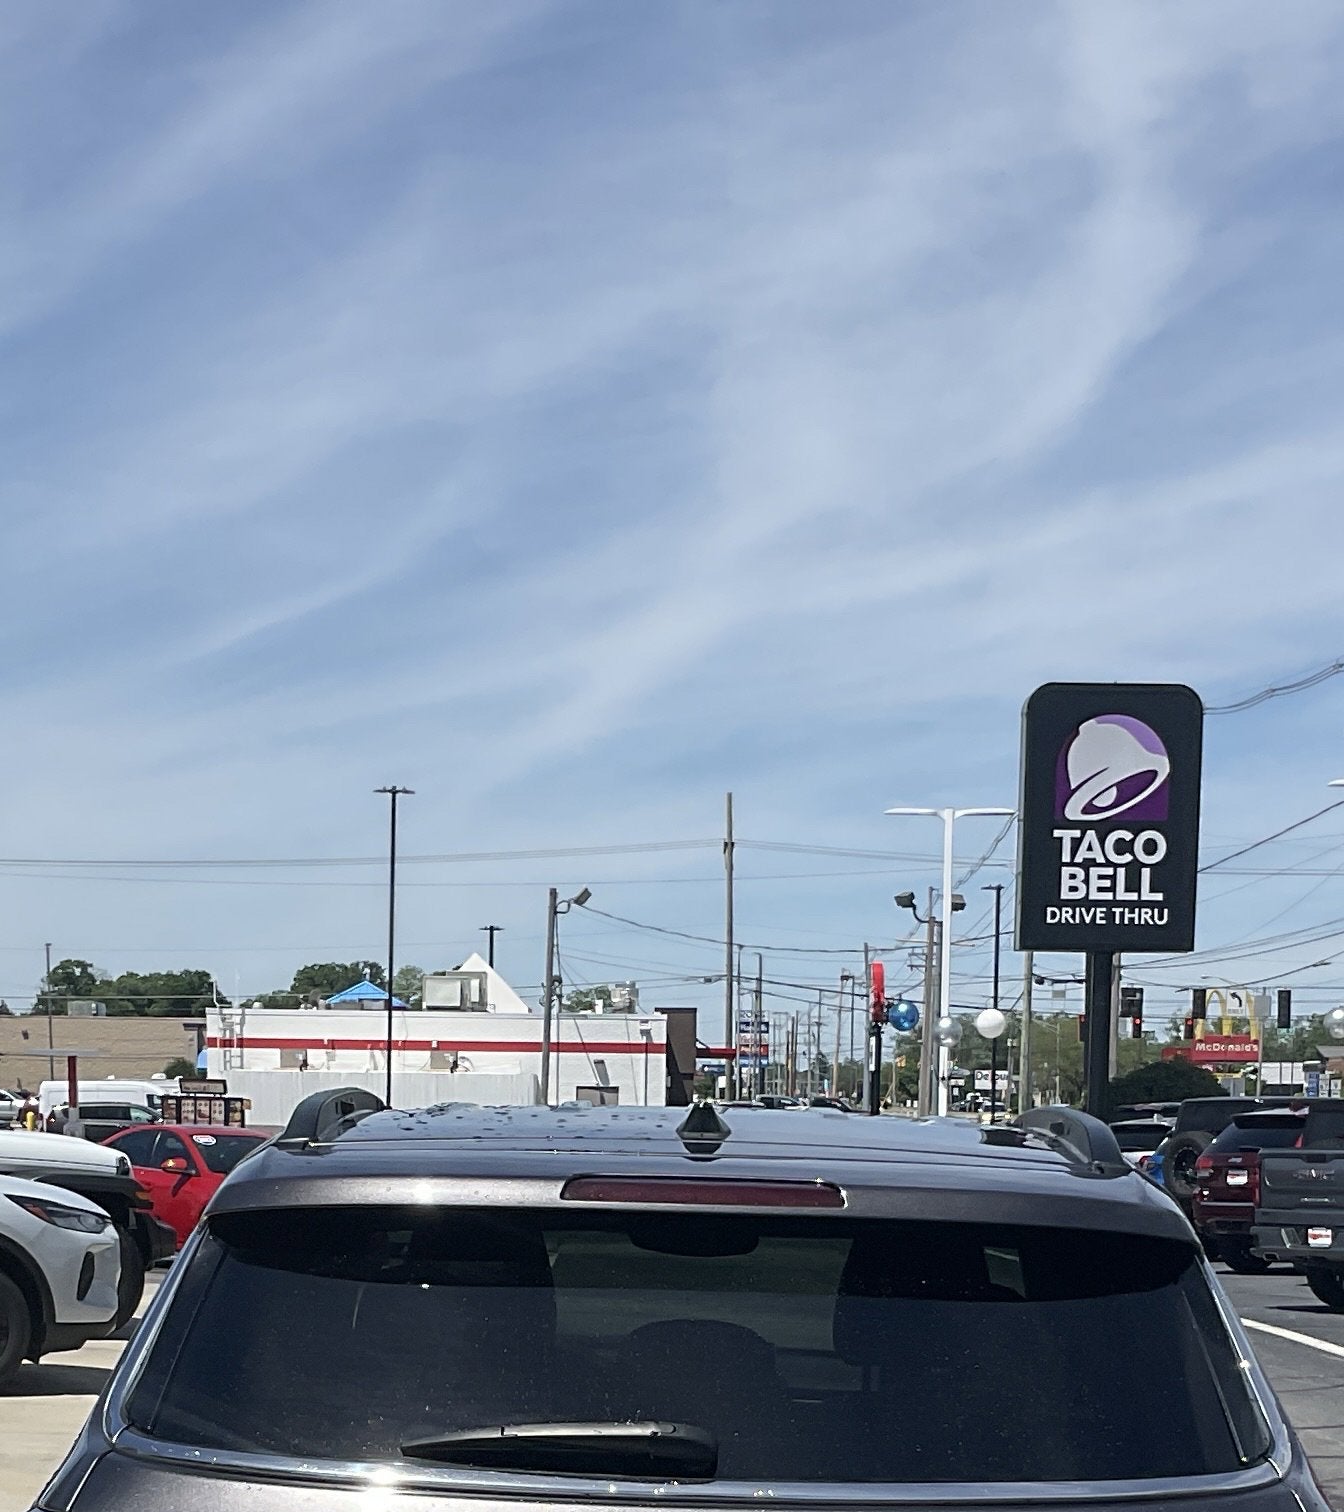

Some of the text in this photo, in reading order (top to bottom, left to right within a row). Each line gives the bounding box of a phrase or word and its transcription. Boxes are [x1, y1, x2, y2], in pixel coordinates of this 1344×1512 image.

[1052, 829, 1167, 864] TACO
[1060, 866, 1164, 901] BELL
[1045, 907, 1169, 925] DRIVE THRU
[1195, 1042, 1259, 1052] McDonald's
